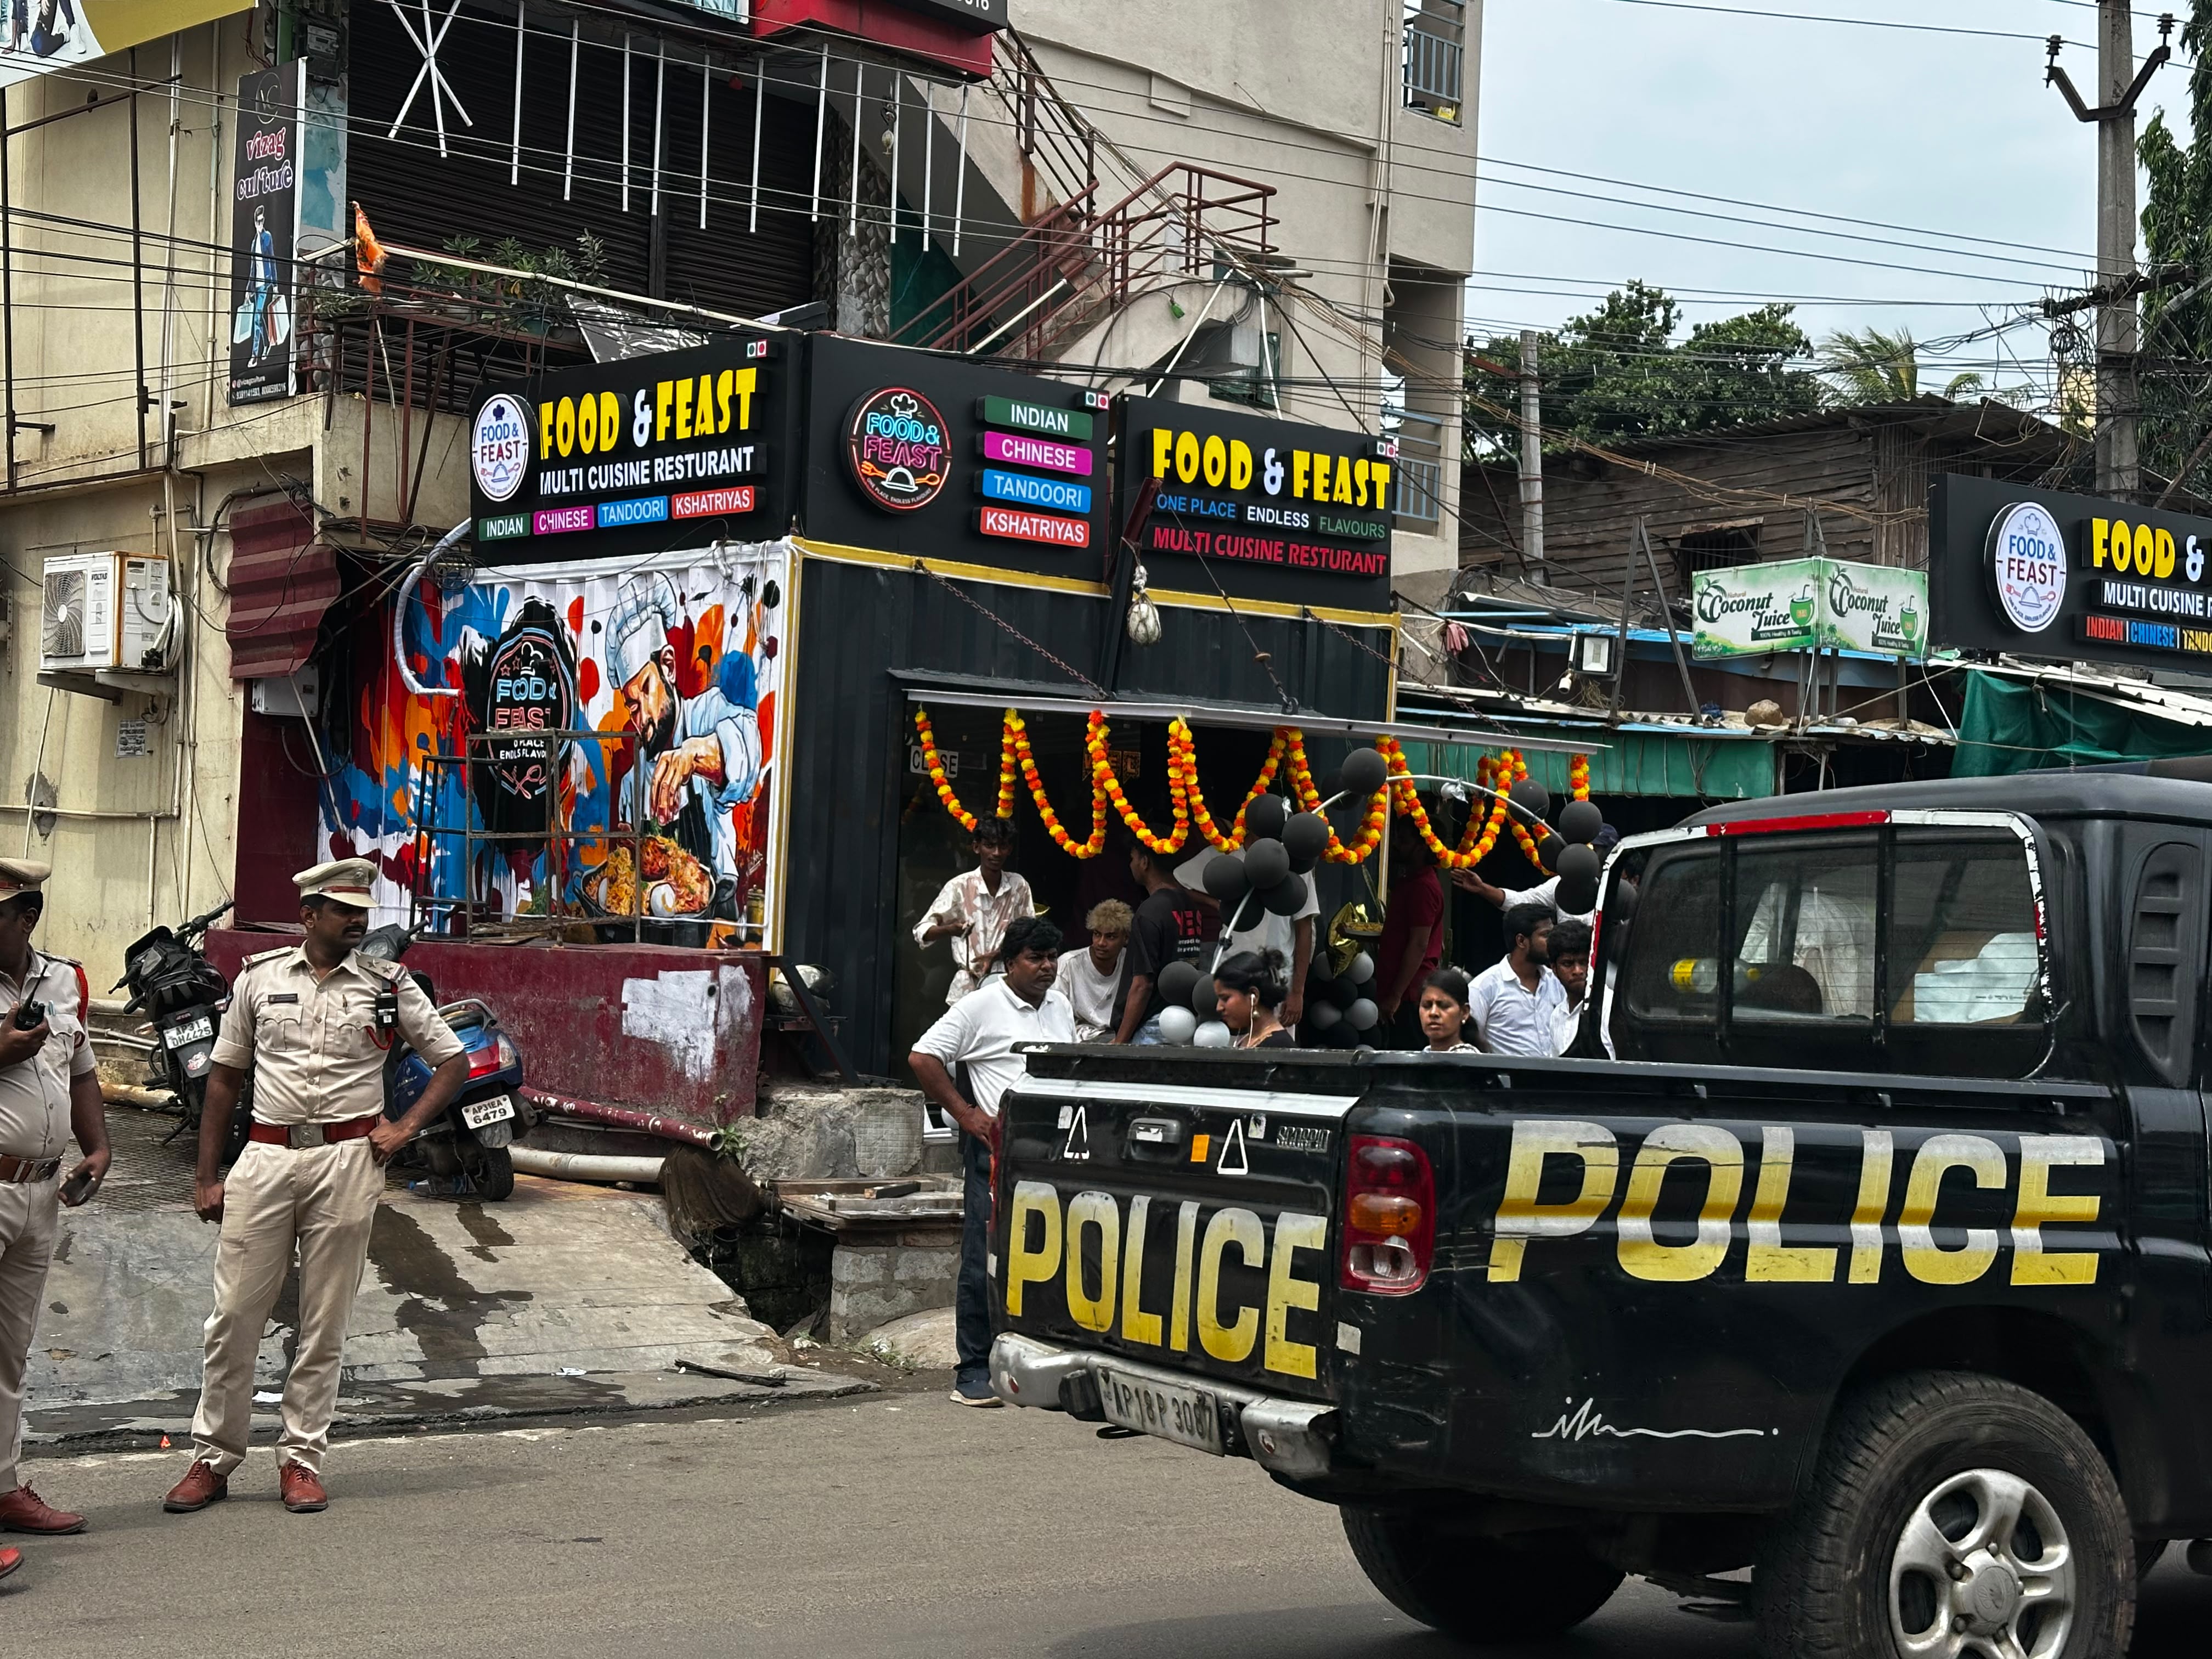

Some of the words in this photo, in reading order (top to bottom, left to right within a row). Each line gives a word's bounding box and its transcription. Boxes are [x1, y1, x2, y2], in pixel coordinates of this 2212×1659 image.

[246, 127, 286, 160] vizag
[237, 160, 293, 200] culture
[539, 391, 620, 460] FOOD
[633, 389, 652, 447] &
[657, 368, 757, 441] FEAST
[867, 412, 924, 442] FOOD
[926, 425, 940, 445] &
[1011, 404, 1068, 432] INDIAN
[481, 423, 510, 443] FOOD
[512, 422, 519, 437] &
[481, 440, 521, 464] FEAST
[864, 435, 943, 471] FEAST
[1002, 439, 1076, 469] CHINESE
[540, 467, 583, 494] MULTI
[588, 460, 650, 488] CUISINE
[654, 446, 754, 482] RESTURANT
[1153, 428, 1252, 490] FOOD
[1263, 448, 1284, 495] &
[1293, 450, 1390, 510] FEAST
[994, 475, 1082, 507] TANDOORI
[487, 518, 523, 538] INDIAN
[539, 509, 589, 532] CHINESE
[602, 499, 664, 524] TANDOORI
[675, 490, 750, 516] KSHATRIYAS
[986, 512, 1084, 543] KSHATRIYAS
[1157, 494, 1186, 511] ONE
[1191, 498, 1236, 518] PLACE
[1247, 506, 1309, 528] ENDLESS
[1320, 516, 1385, 539] FLAVOURS
[1153, 527, 1211, 554] MULTI
[1215, 534, 1283, 562] CUISINE
[1288, 544, 1386, 575] RESTURANT
[2009, 534, 2045, 559] FOOD
[2048, 543, 2056, 561] &
[2092, 517, 2175, 578] FOOD
[2186, 535, 2204, 582] &
[2008, 558, 2057, 586] FEAST
[1708, 592, 1774, 621] Coconut
[1838, 585, 1888, 615] Coconut
[2104, 582, 2146, 608] MULTI
[2149, 588, 2203, 616] CUISINE
[1751, 610, 1790, 631] Juice
[1872, 613, 1900, 635] Juice
[2086, 616, 2124, 641] INDIAN
[2130, 622, 2174, 647] CHINESE
[912, 750, 957, 775] CLSE
[472, 1099, 503, 1115] AP31EA
[473, 1108, 507, 1124] 6479
[1486, 1120, 2105, 1286] POLICE
[1007, 1181, 1328, 1380] POLICE
